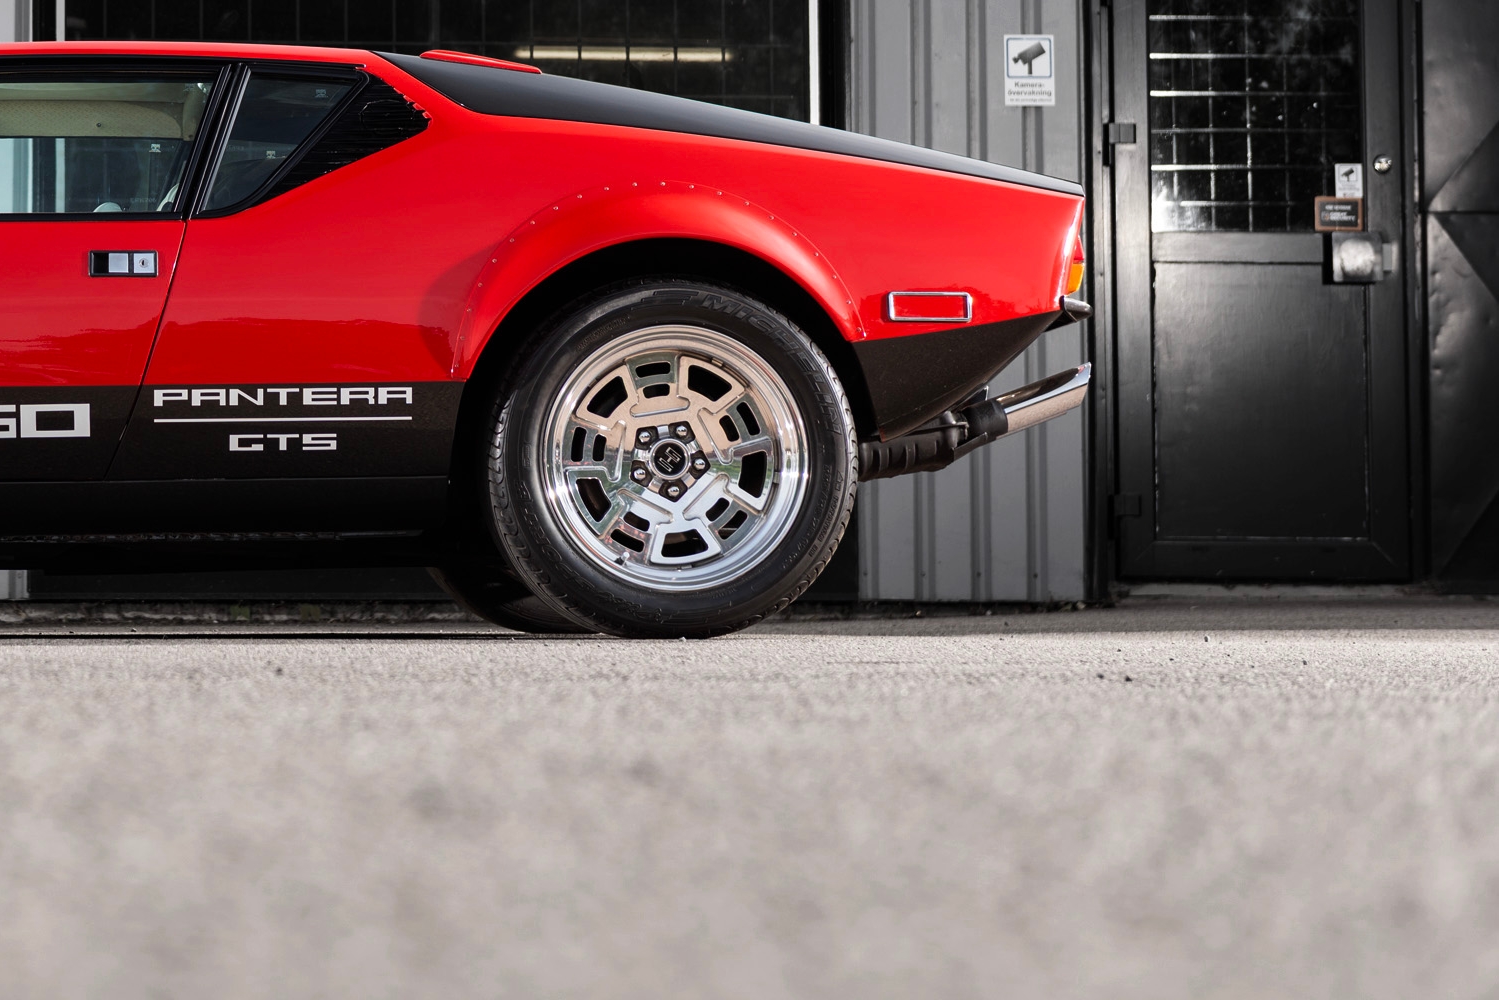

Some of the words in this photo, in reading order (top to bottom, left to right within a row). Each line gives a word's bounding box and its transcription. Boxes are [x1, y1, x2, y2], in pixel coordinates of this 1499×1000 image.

[701, 293, 844, 436] MICHELIN
[153, 387, 413, 406] PANTERA
[229, 433, 337, 451] GTS
